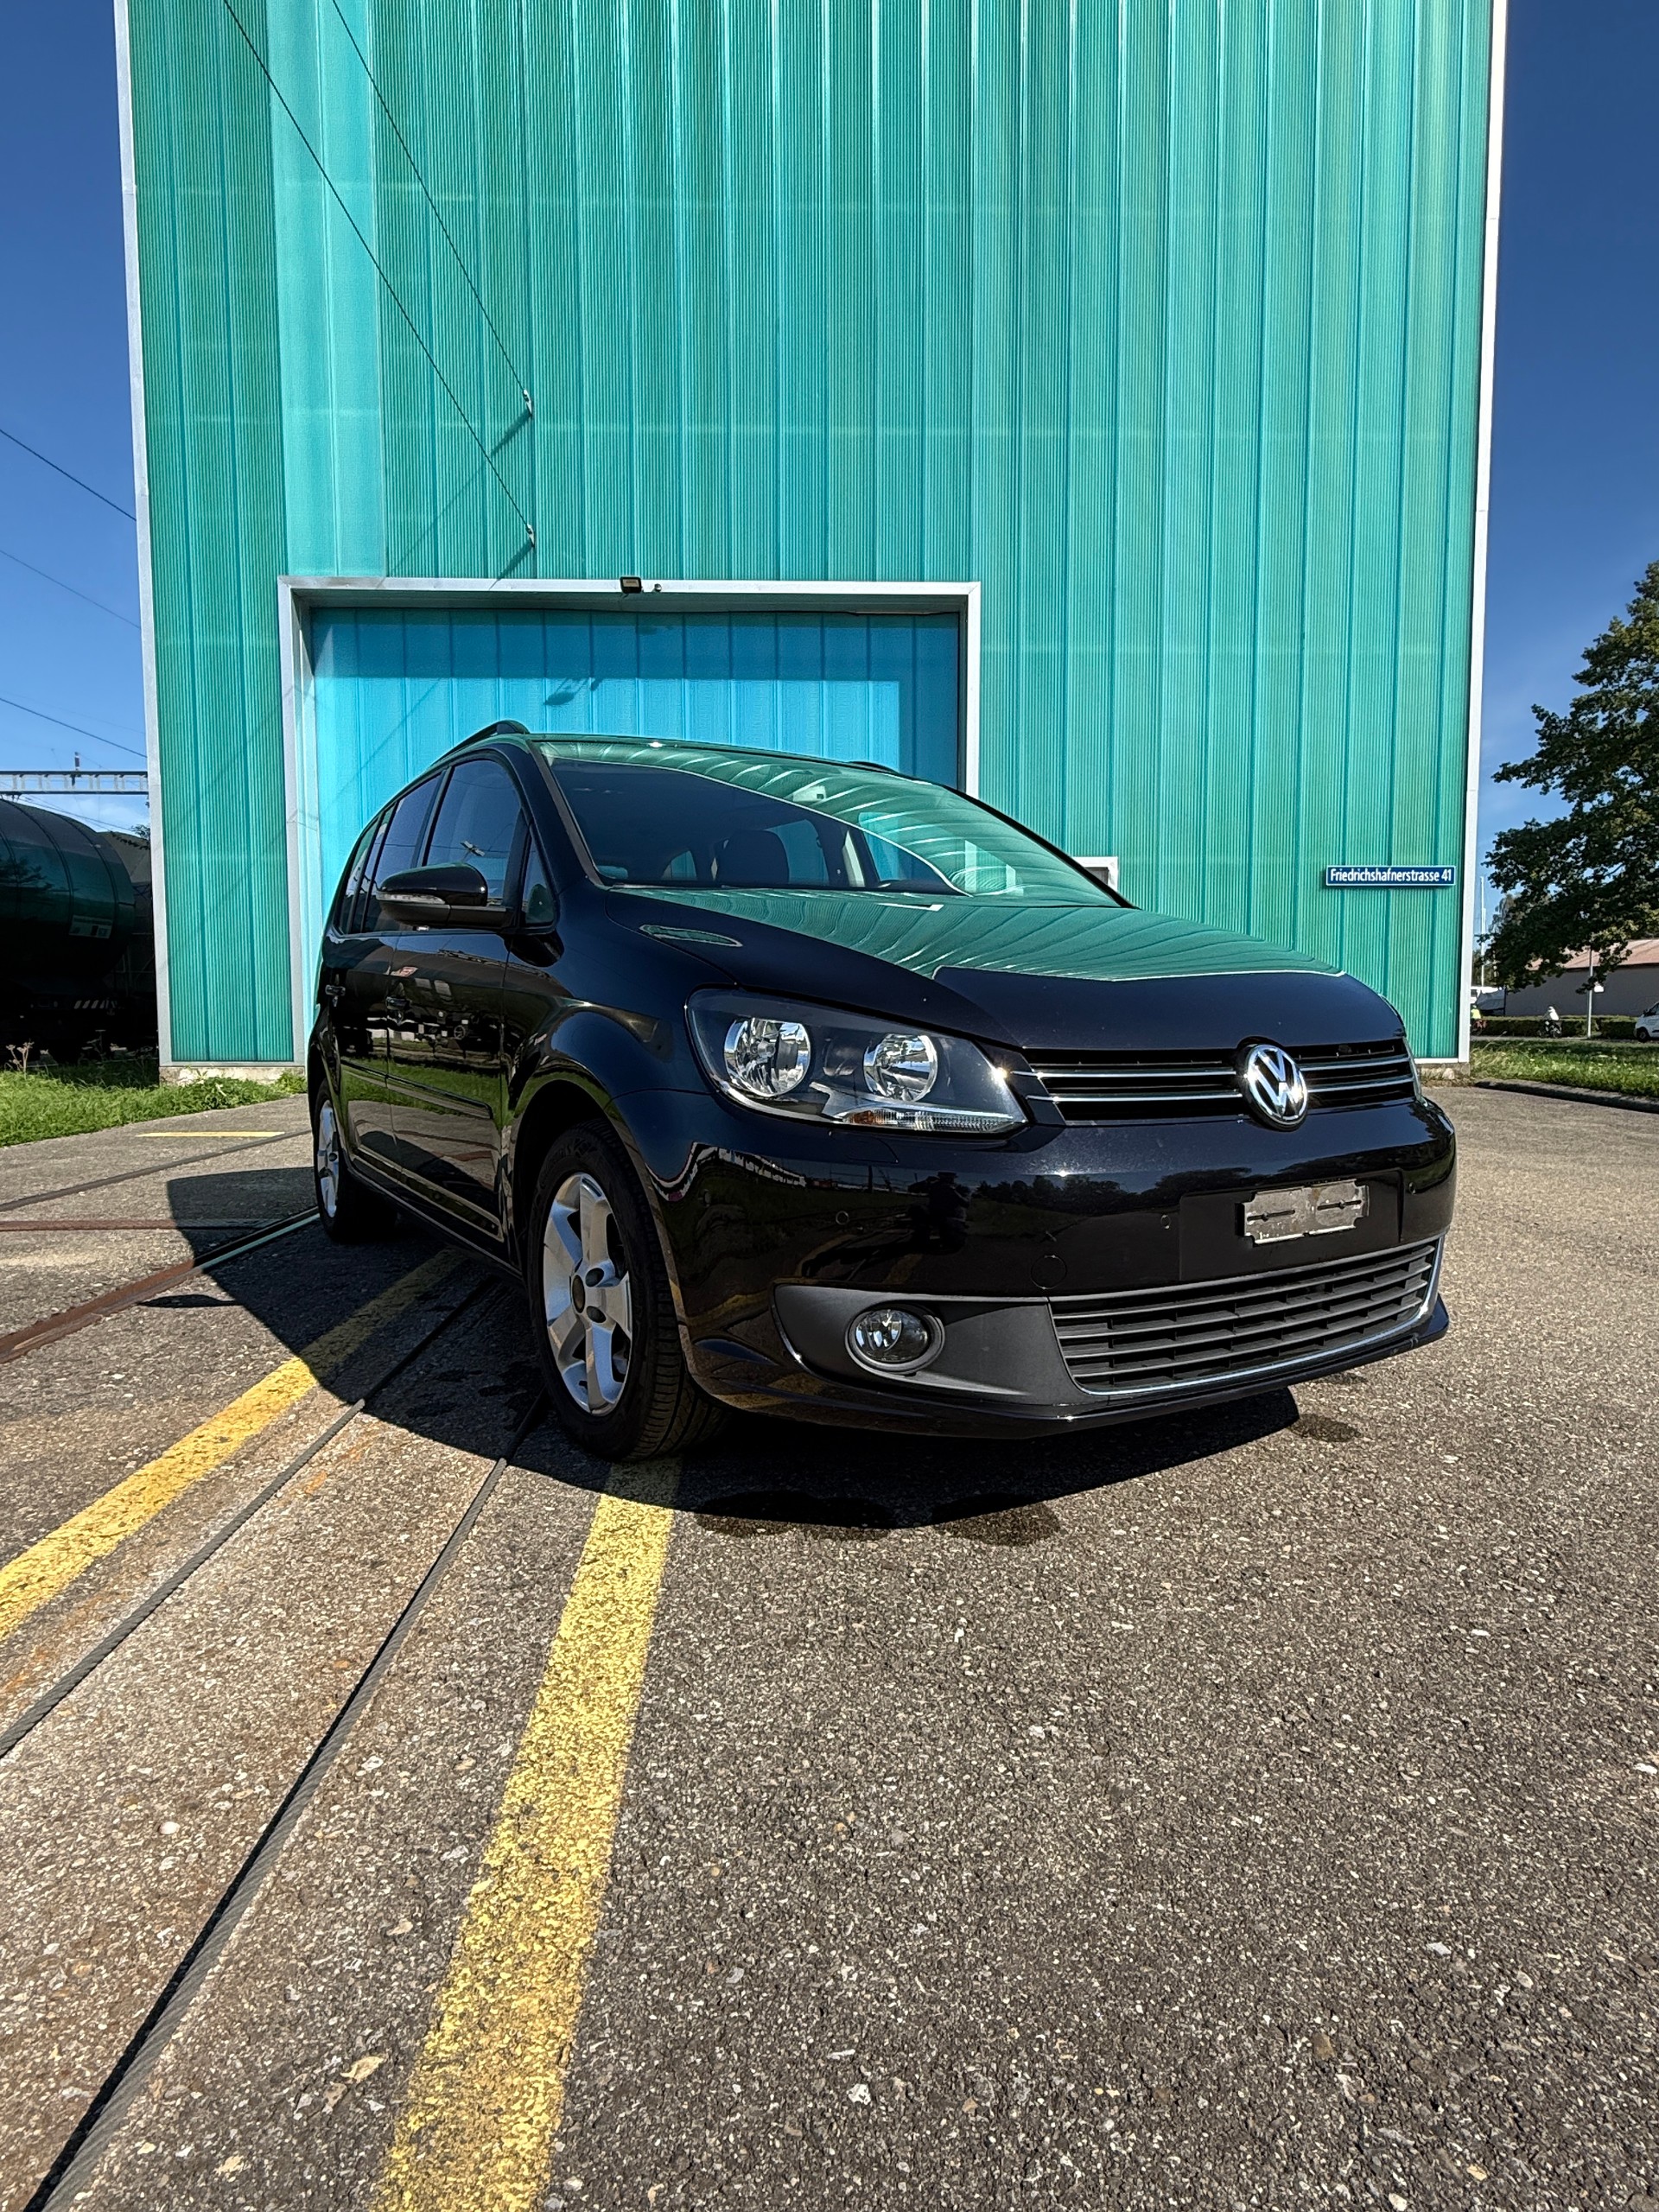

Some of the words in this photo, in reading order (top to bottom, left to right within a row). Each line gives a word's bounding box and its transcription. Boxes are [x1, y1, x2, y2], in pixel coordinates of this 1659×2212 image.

[1330, 868, 1440, 882] Friedrichshafnerstrasse
[1440, 868, 1452, 881] 41
[1249, 1046, 1303, 1122] VW
